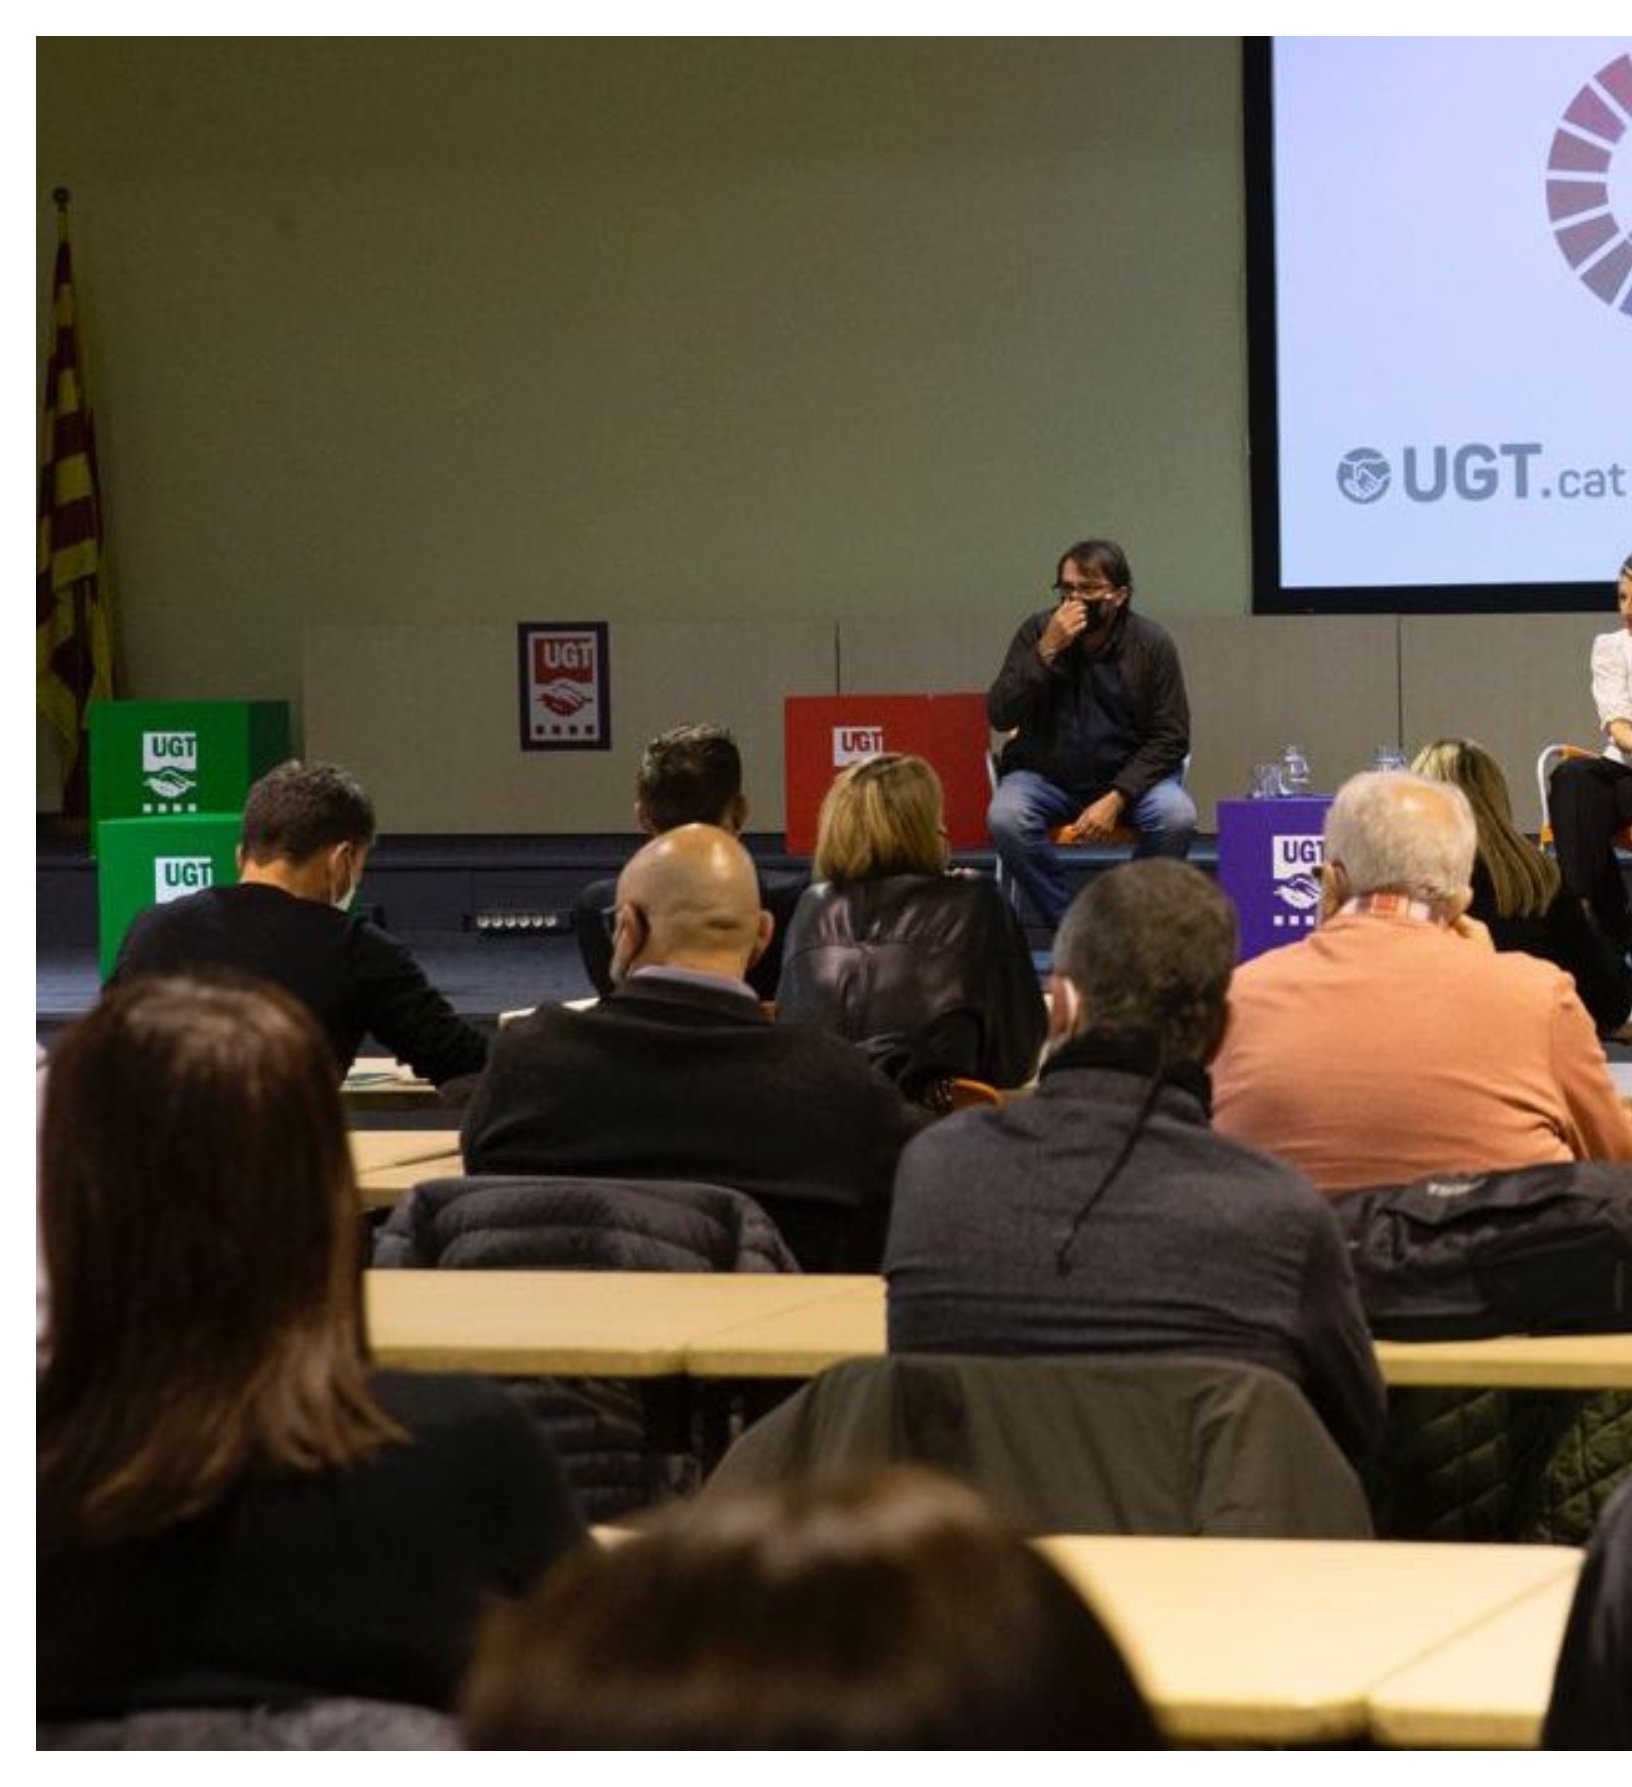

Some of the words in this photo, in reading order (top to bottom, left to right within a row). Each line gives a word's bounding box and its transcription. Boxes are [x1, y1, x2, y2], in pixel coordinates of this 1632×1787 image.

[1403, 442, 1627, 503] UGT.cat
[545, 641, 594, 670] UGT
[152, 736, 196, 758] UGT
[841, 731, 882, 753] UGT
[165, 862, 212, 887] UGT
